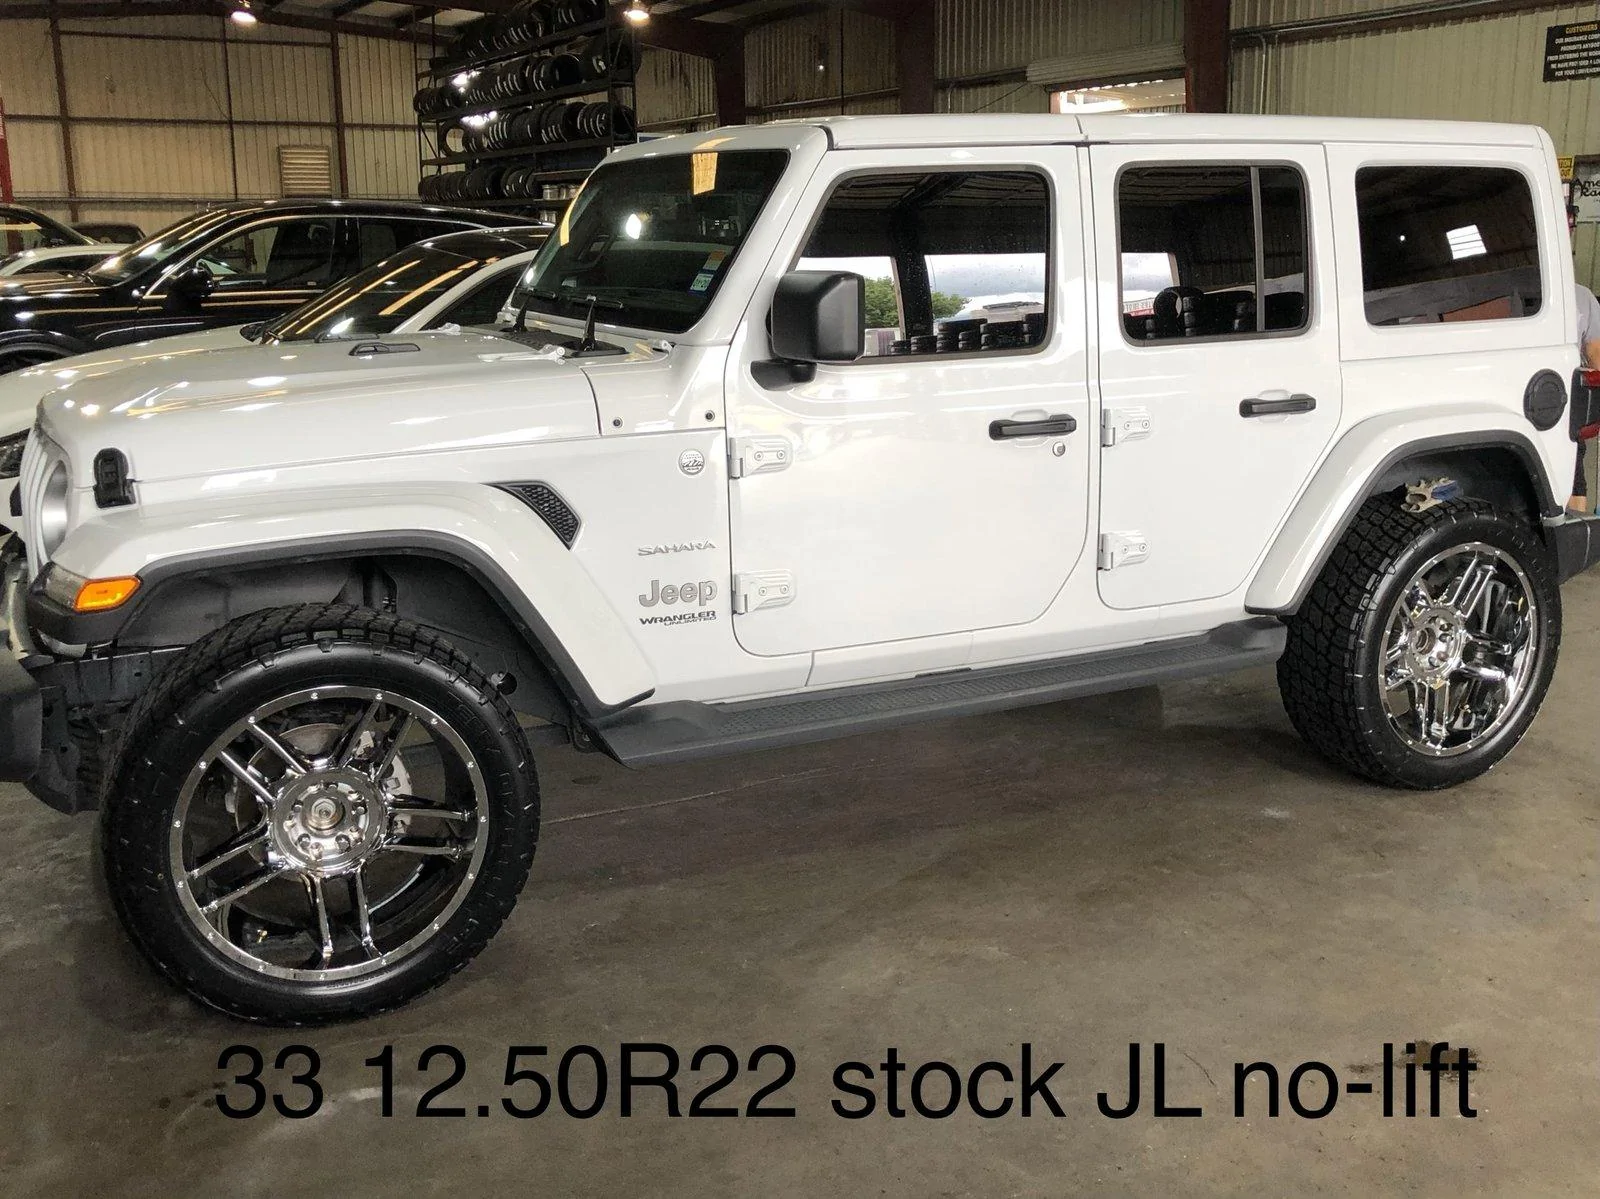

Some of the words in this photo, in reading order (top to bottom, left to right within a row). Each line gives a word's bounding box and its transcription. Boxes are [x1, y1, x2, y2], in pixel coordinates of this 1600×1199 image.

[1566, 24, 1598, 34] CUSTOMERS
[638, 540, 716, 556] SAHARA
[638, 579, 718, 608] Jeep
[639, 610, 716, 625] WRANGLER
[664, 616, 717, 626] UNLIMITED
